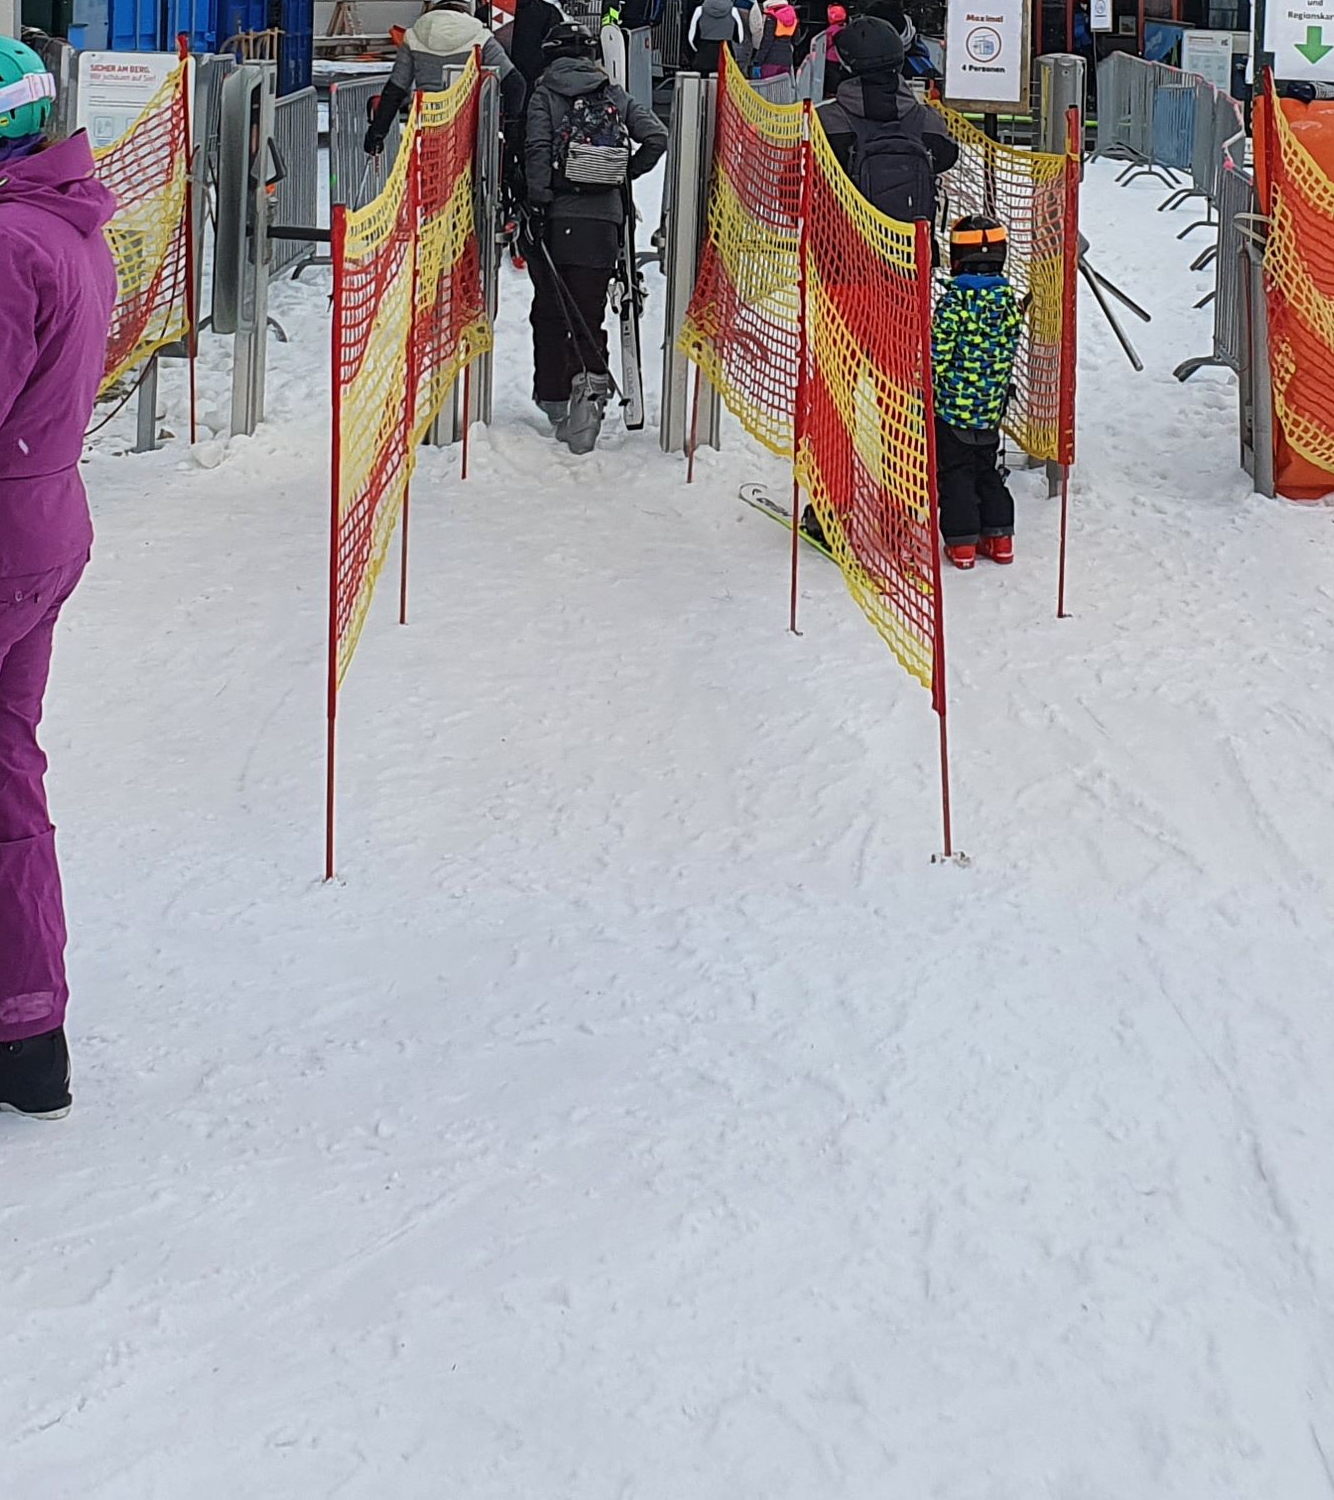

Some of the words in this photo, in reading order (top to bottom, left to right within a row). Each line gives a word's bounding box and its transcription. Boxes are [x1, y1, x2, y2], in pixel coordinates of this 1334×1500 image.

[1307, 0, 1324, 7] und
[966, 14, 1004, 23] Maximal
[968, 64, 1006, 73] Personen
